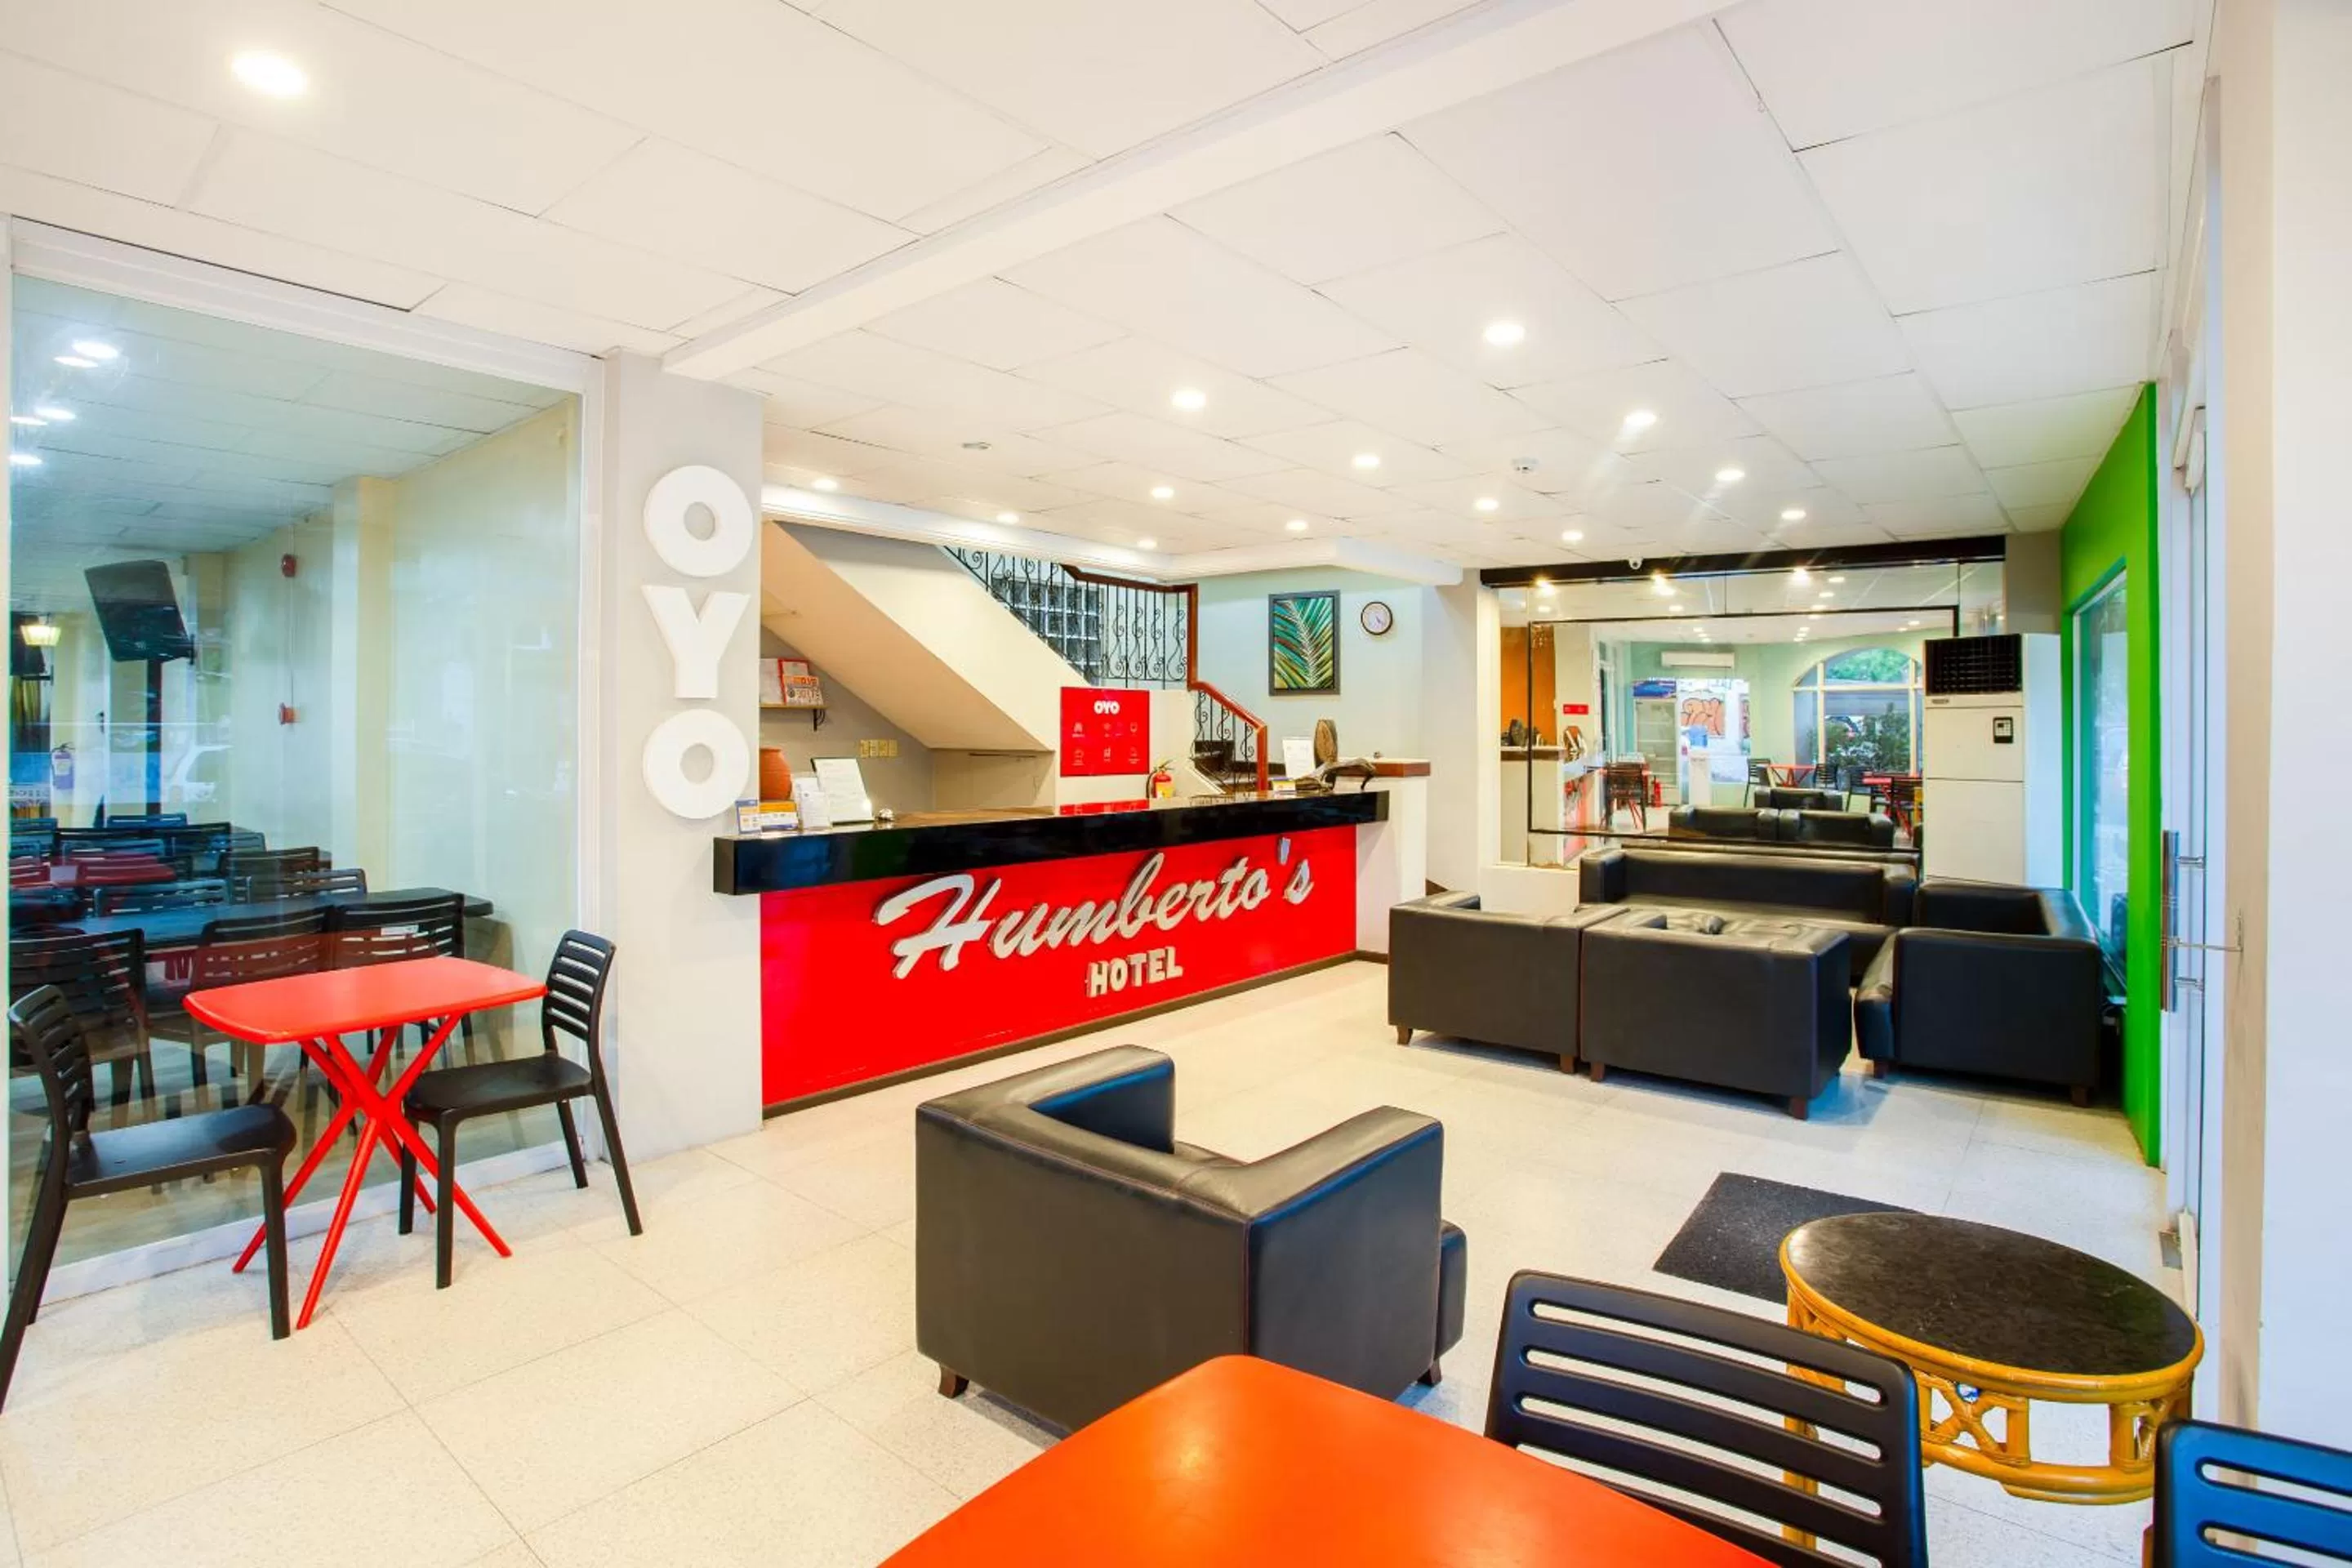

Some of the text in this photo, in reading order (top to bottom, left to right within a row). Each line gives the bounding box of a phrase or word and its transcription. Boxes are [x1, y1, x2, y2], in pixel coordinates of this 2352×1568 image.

[643, 465, 753, 819] OYO
[1094, 700, 1120, 715] OYO
[874, 837, 1313, 980] Humberto's
[1087, 947, 1183, 997] HOTEL
